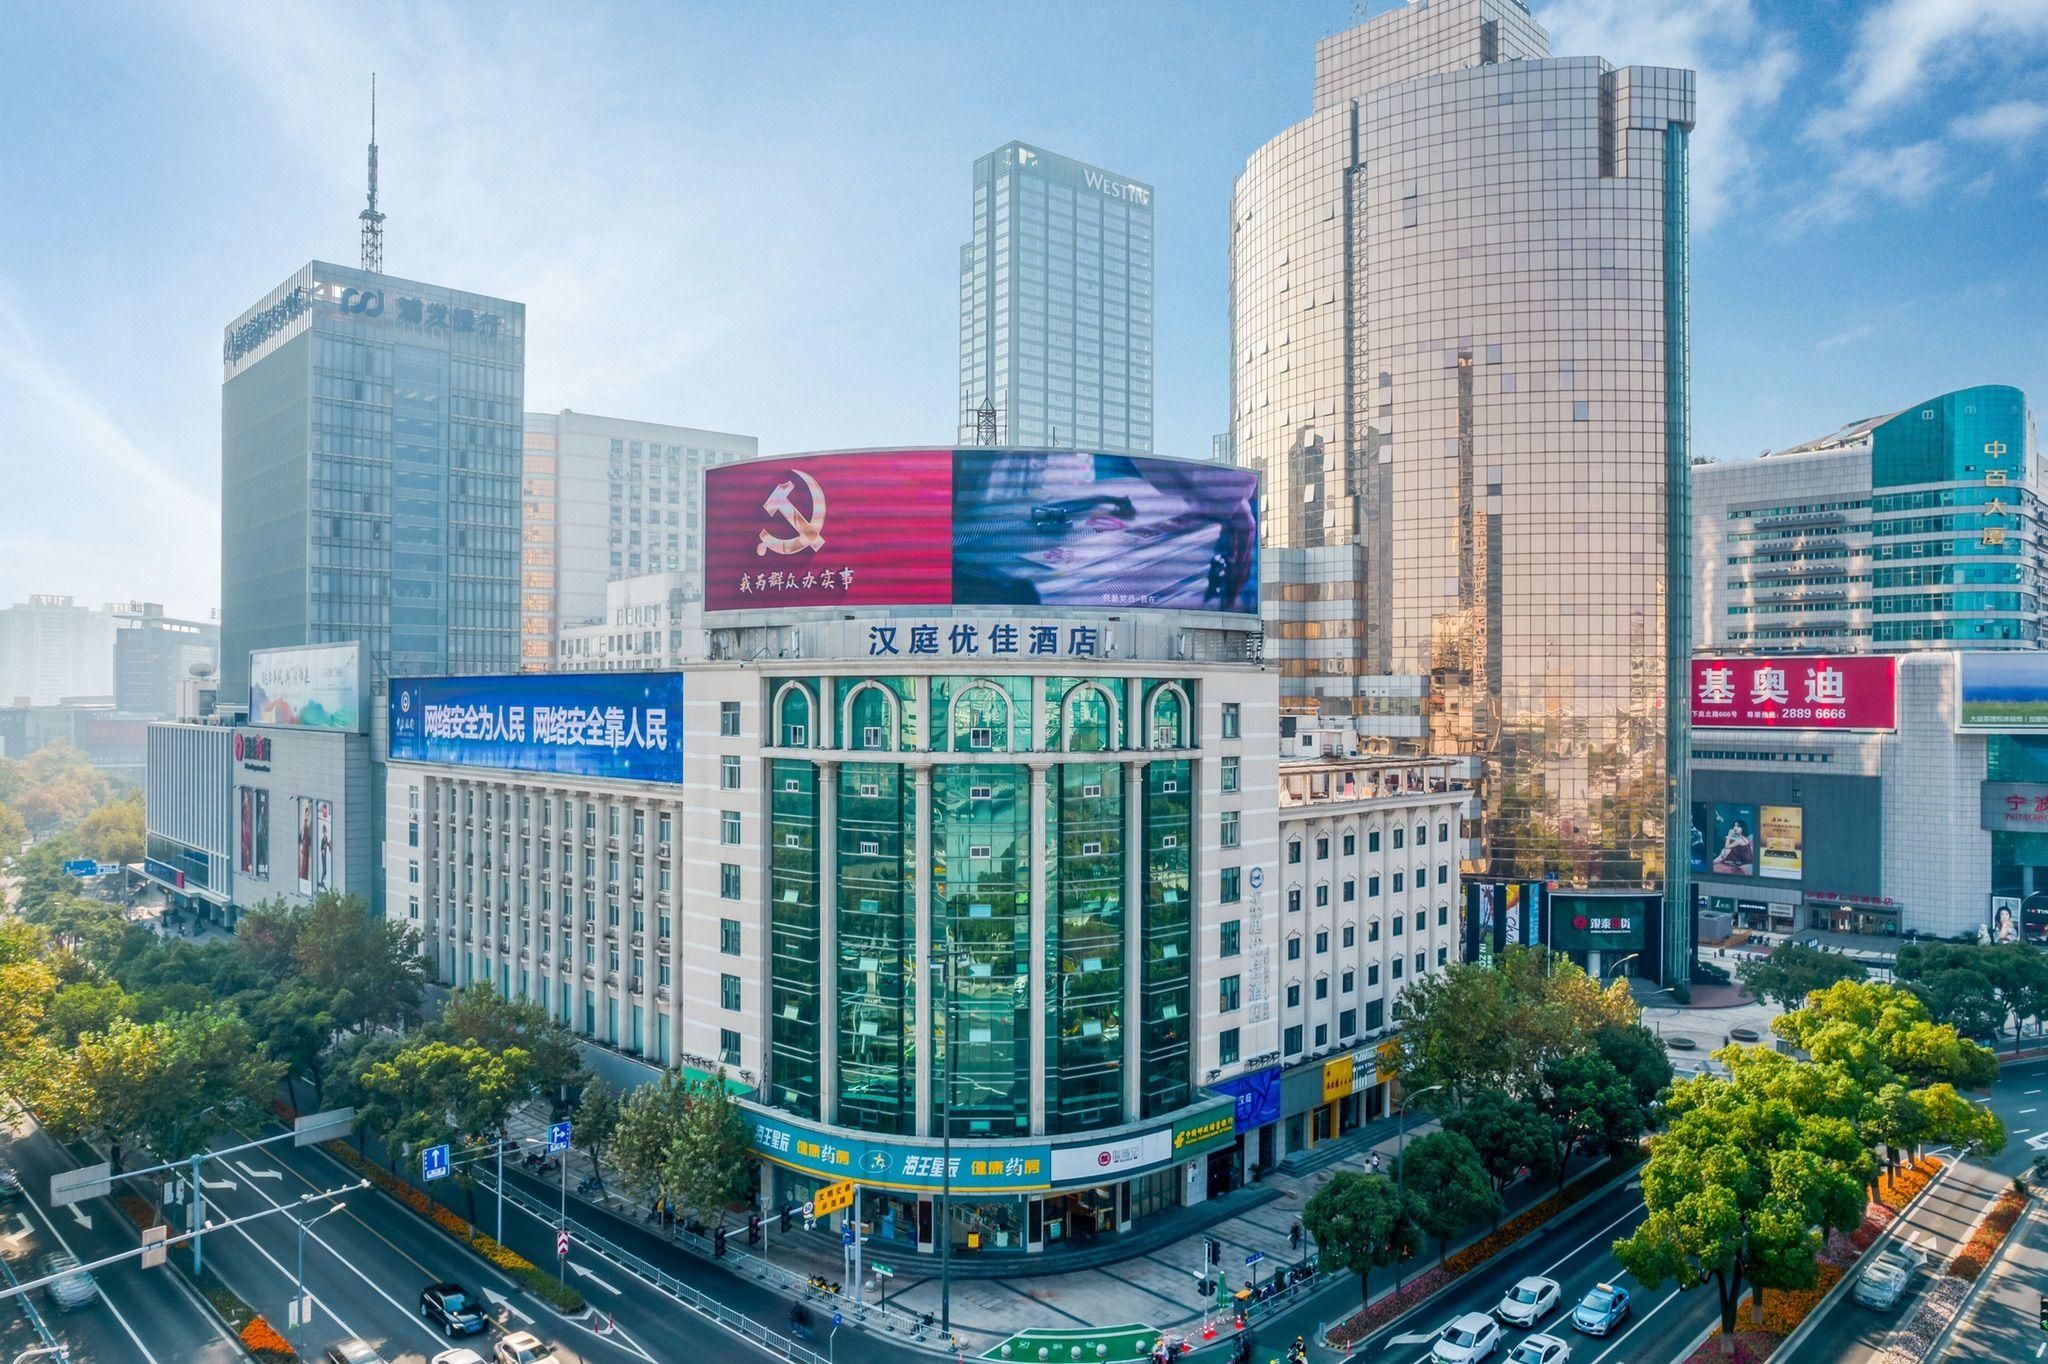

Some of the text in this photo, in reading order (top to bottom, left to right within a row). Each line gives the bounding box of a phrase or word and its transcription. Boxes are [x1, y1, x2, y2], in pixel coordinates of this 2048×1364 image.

[1983, 440, 2008, 545] 中百大厦
[740, 567, 855, 594] 我为群众办实事
[868, 624, 1097, 655] 汉庭优佳酒店
[1698, 666, 1846, 704] 基奥迪
[1782, 708, 1812, 719] 2889
[1815, 708, 1846, 719] 6666
[424, 704, 668, 751] 网络安全为人民 网络安全靠人民
[797, 1139, 850, 1165] 健康药房
[902, 1154, 961, 1178] 海王星辰
[971, 1157, 1040, 1177] 健康药房
